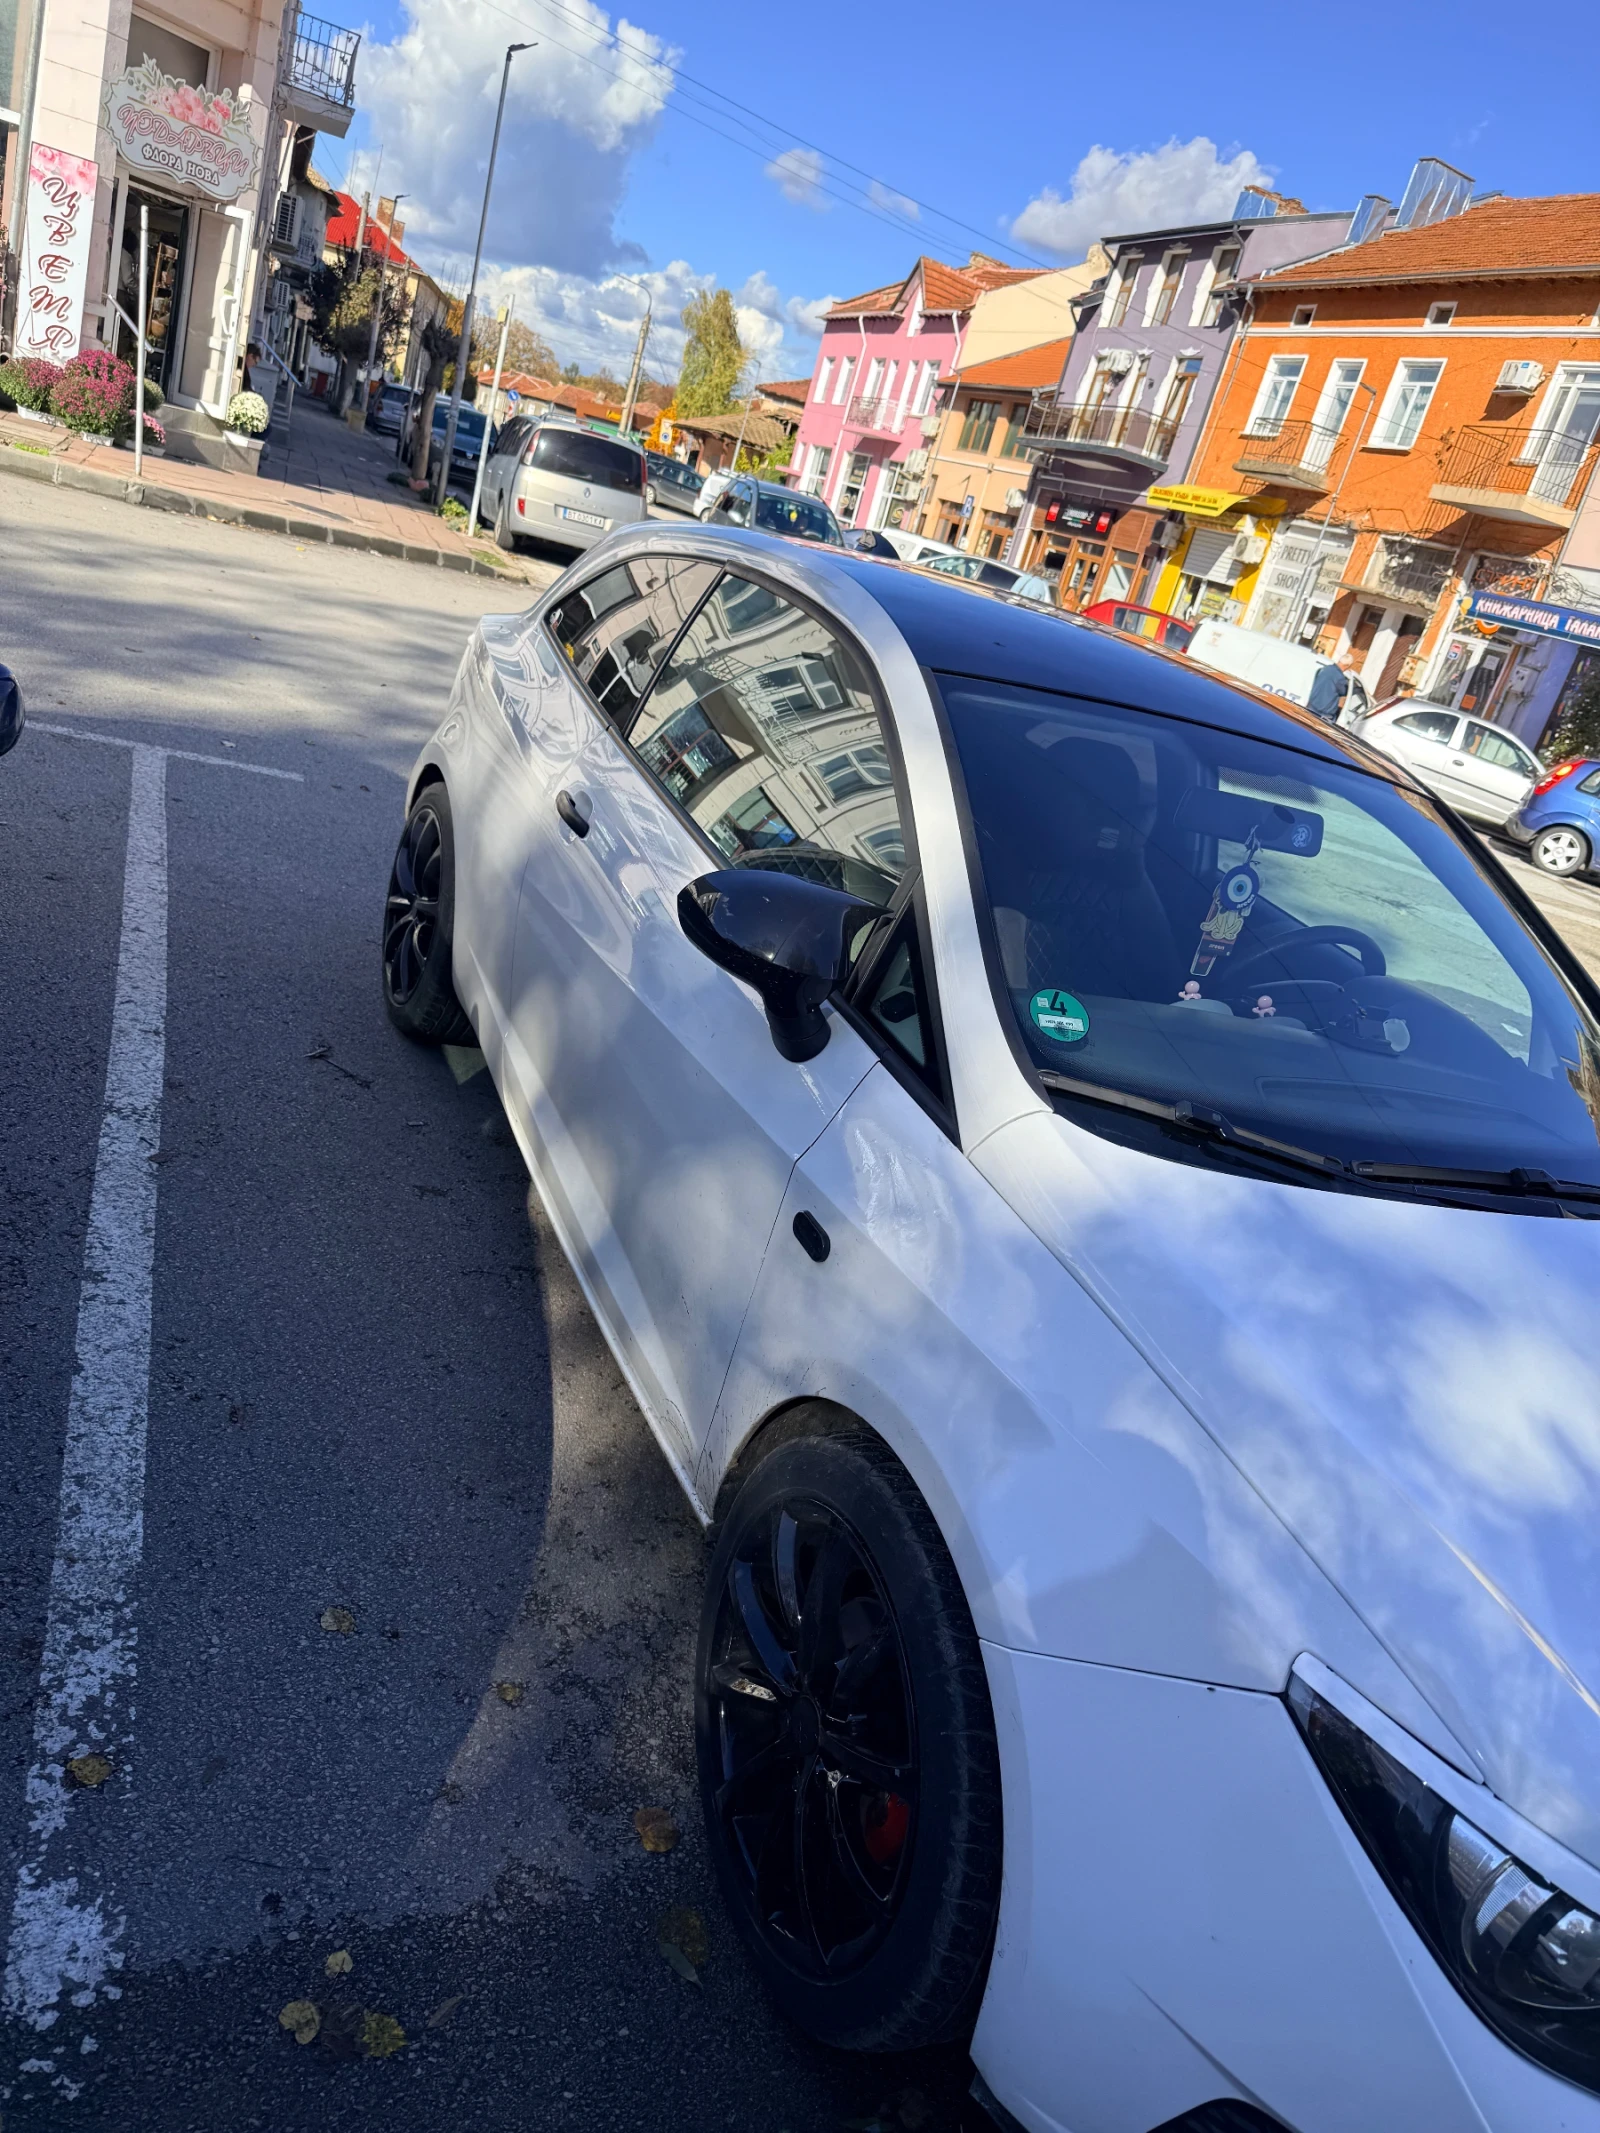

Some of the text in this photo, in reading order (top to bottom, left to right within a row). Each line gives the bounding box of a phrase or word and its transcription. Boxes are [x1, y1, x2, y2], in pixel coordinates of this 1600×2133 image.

[141, 143, 221, 187] ФЛОРА НОВА
[1281, 545, 1313, 566] PRETTY
[1274, 572, 1300, 592] SHOP
[1475, 597, 1560, 631] КНИЖАРНИЦА
[1050, 991, 1067, 1016] 4
